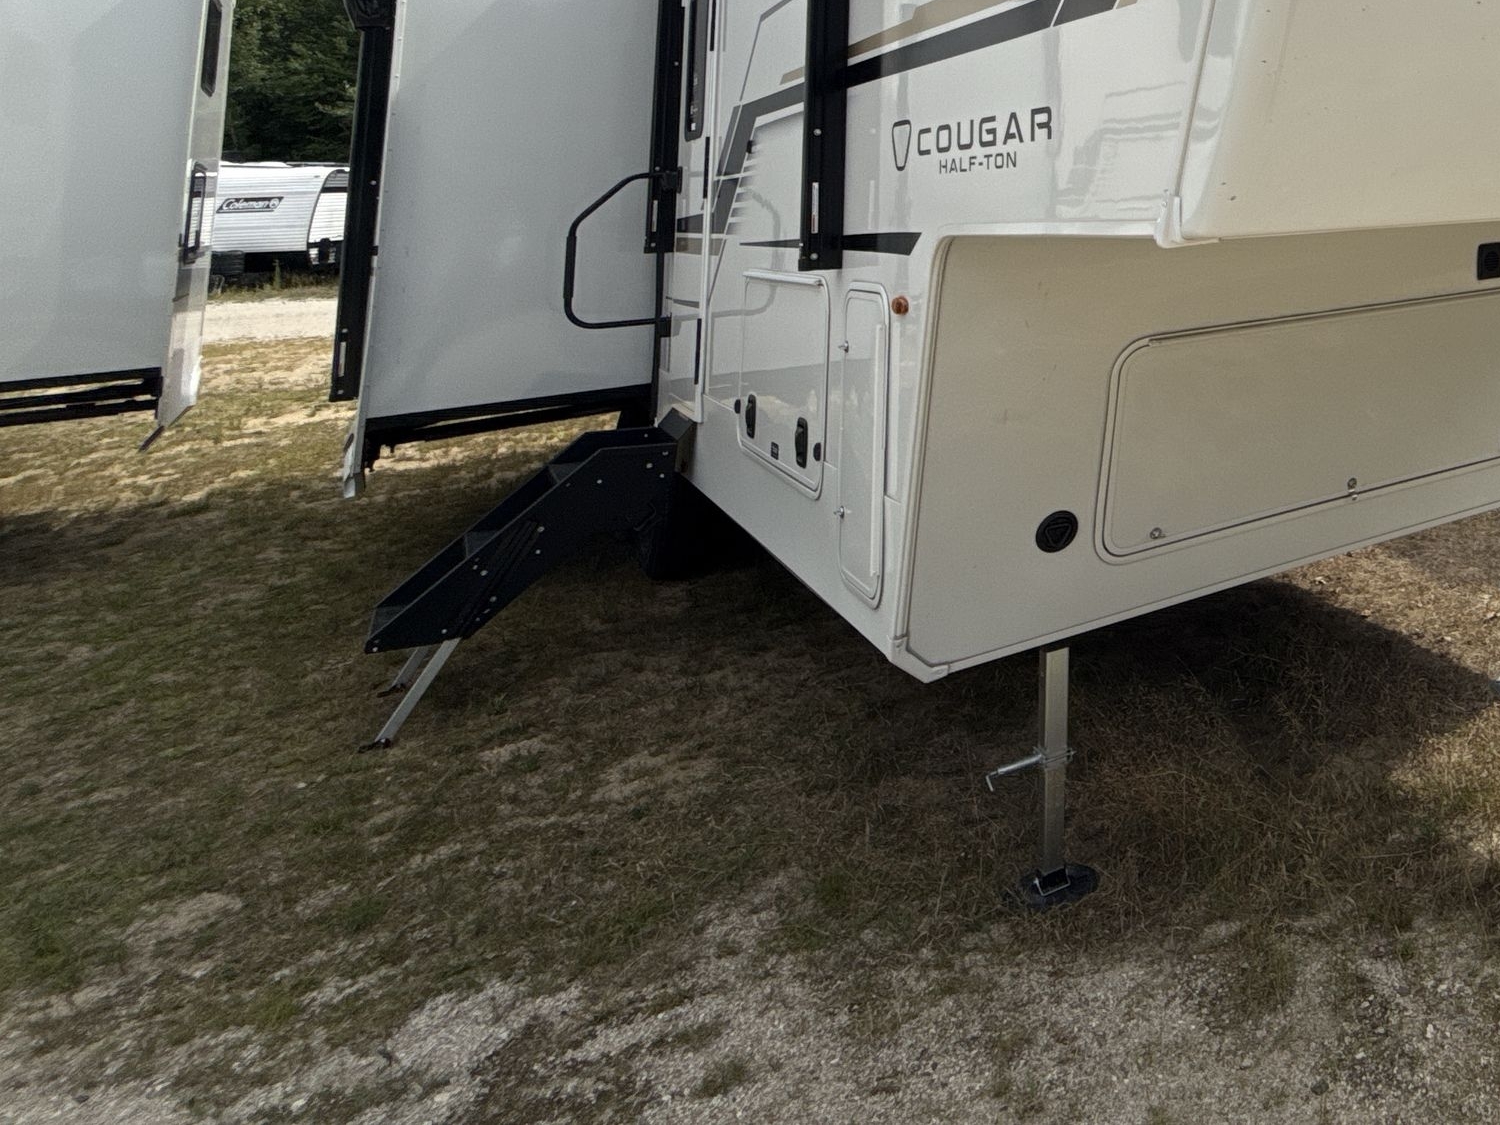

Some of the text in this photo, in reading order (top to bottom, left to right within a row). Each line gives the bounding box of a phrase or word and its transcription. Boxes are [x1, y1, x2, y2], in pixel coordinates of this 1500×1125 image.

[917, 106, 1052, 156] COUGAR
[939, 151, 1017, 174] HALF-TON
[222, 198, 269, 210] Coleman
